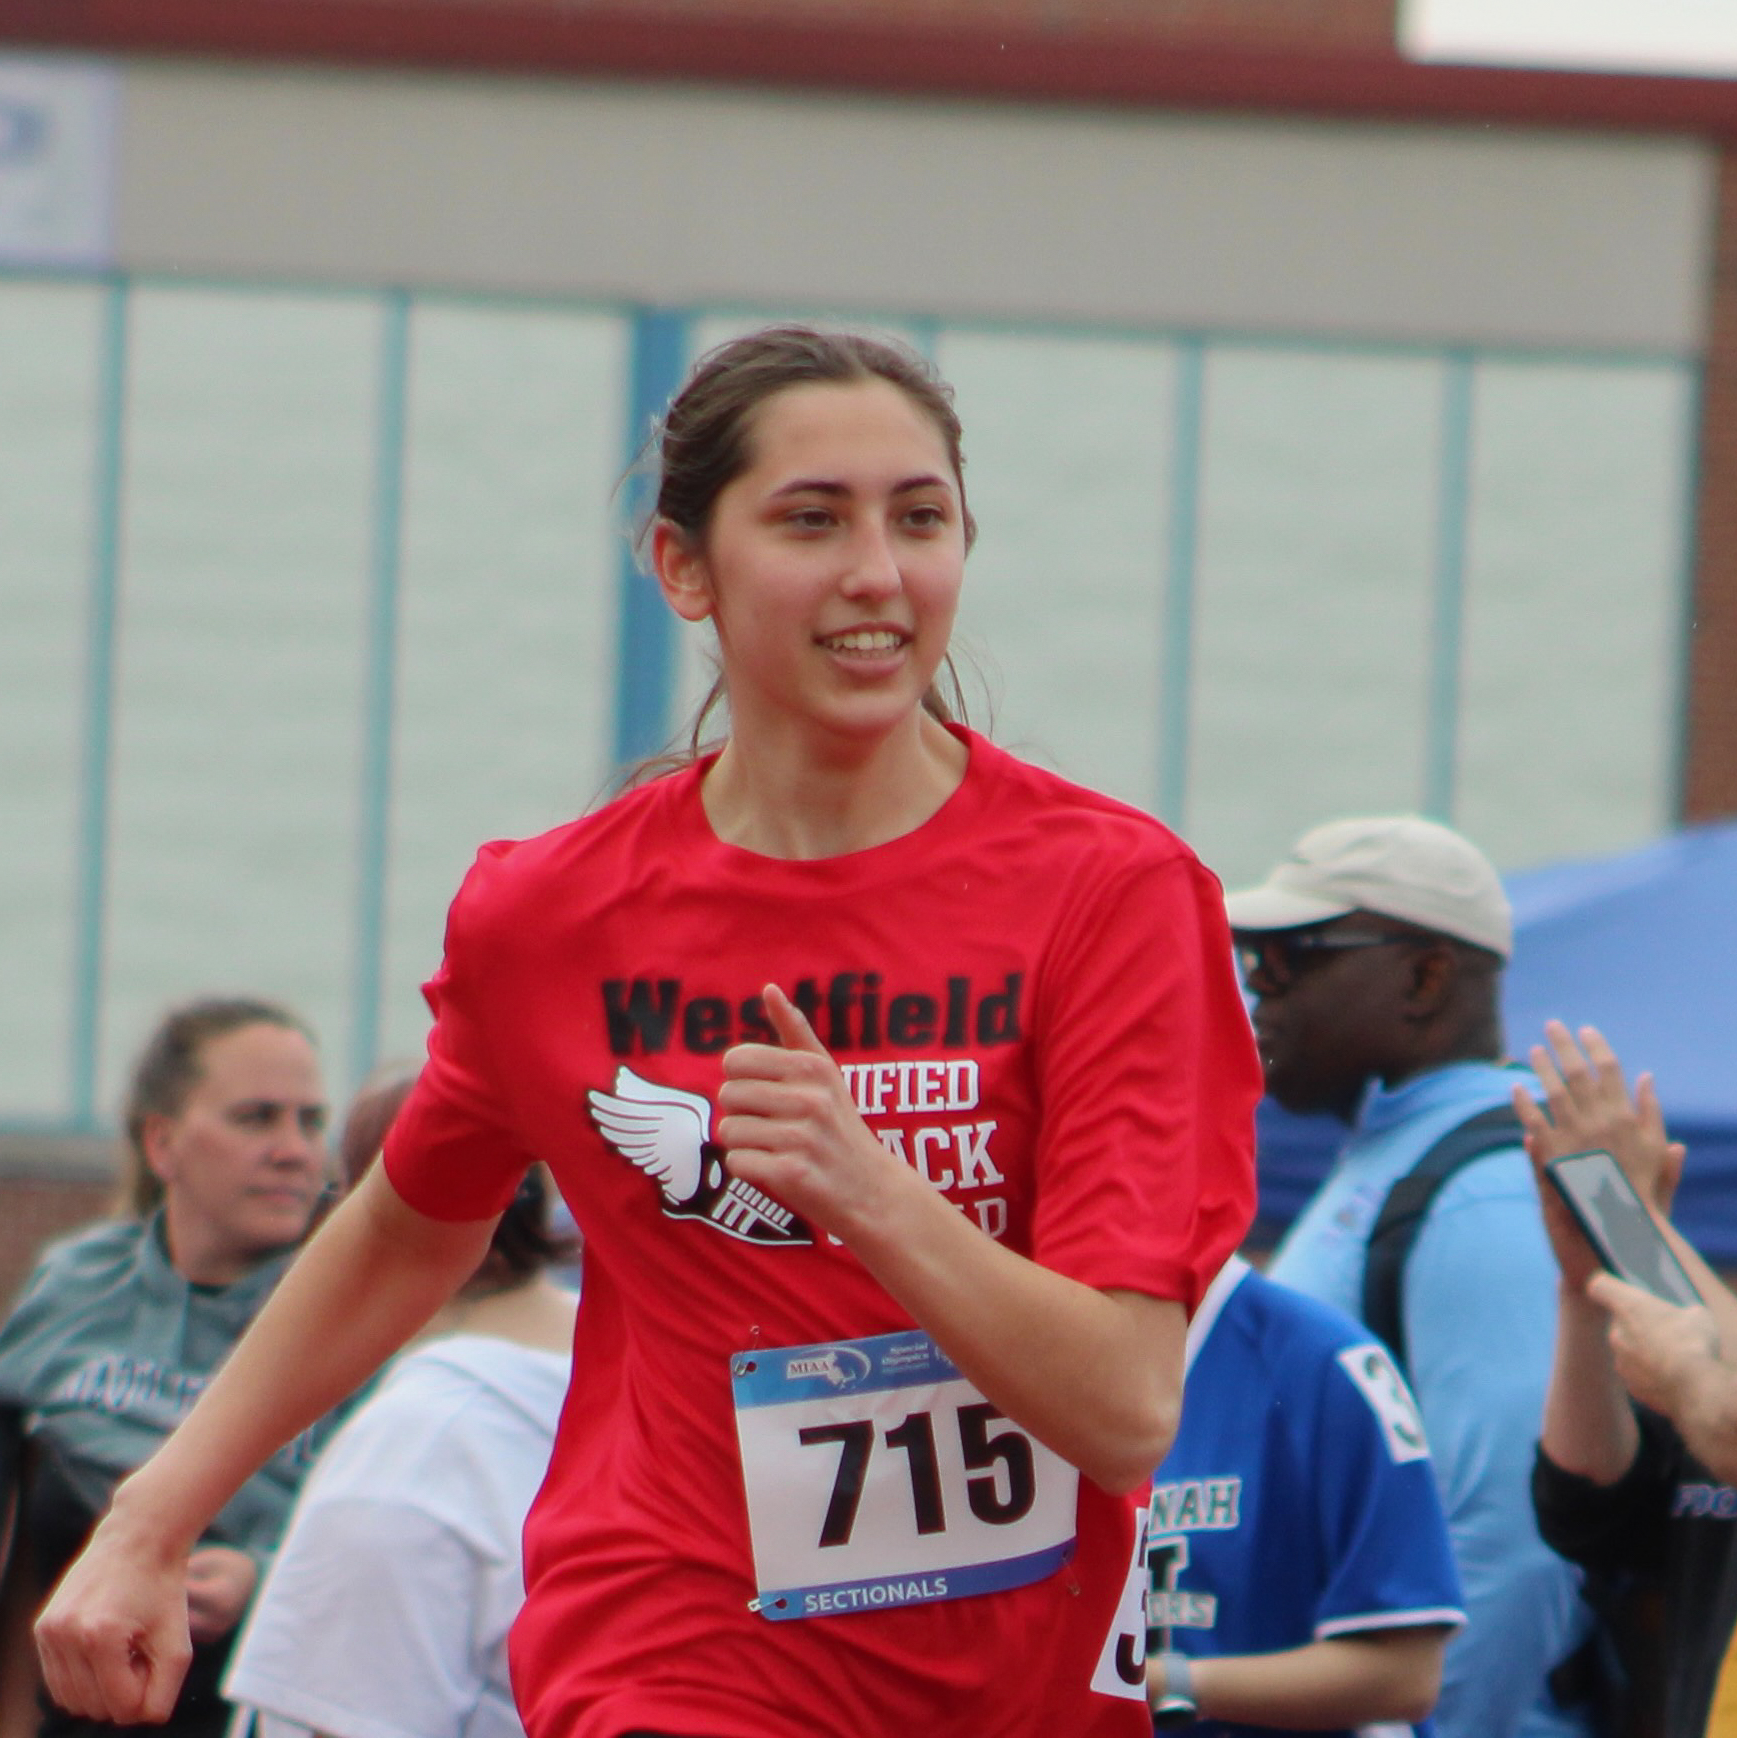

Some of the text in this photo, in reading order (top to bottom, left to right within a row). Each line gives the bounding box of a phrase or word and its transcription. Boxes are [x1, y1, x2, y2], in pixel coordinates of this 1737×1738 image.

[600, 970, 1024, 1058] Westfield
[799, 1400, 1038, 1549] 715
[804, 1577, 949, 1613] SECTIONALS
